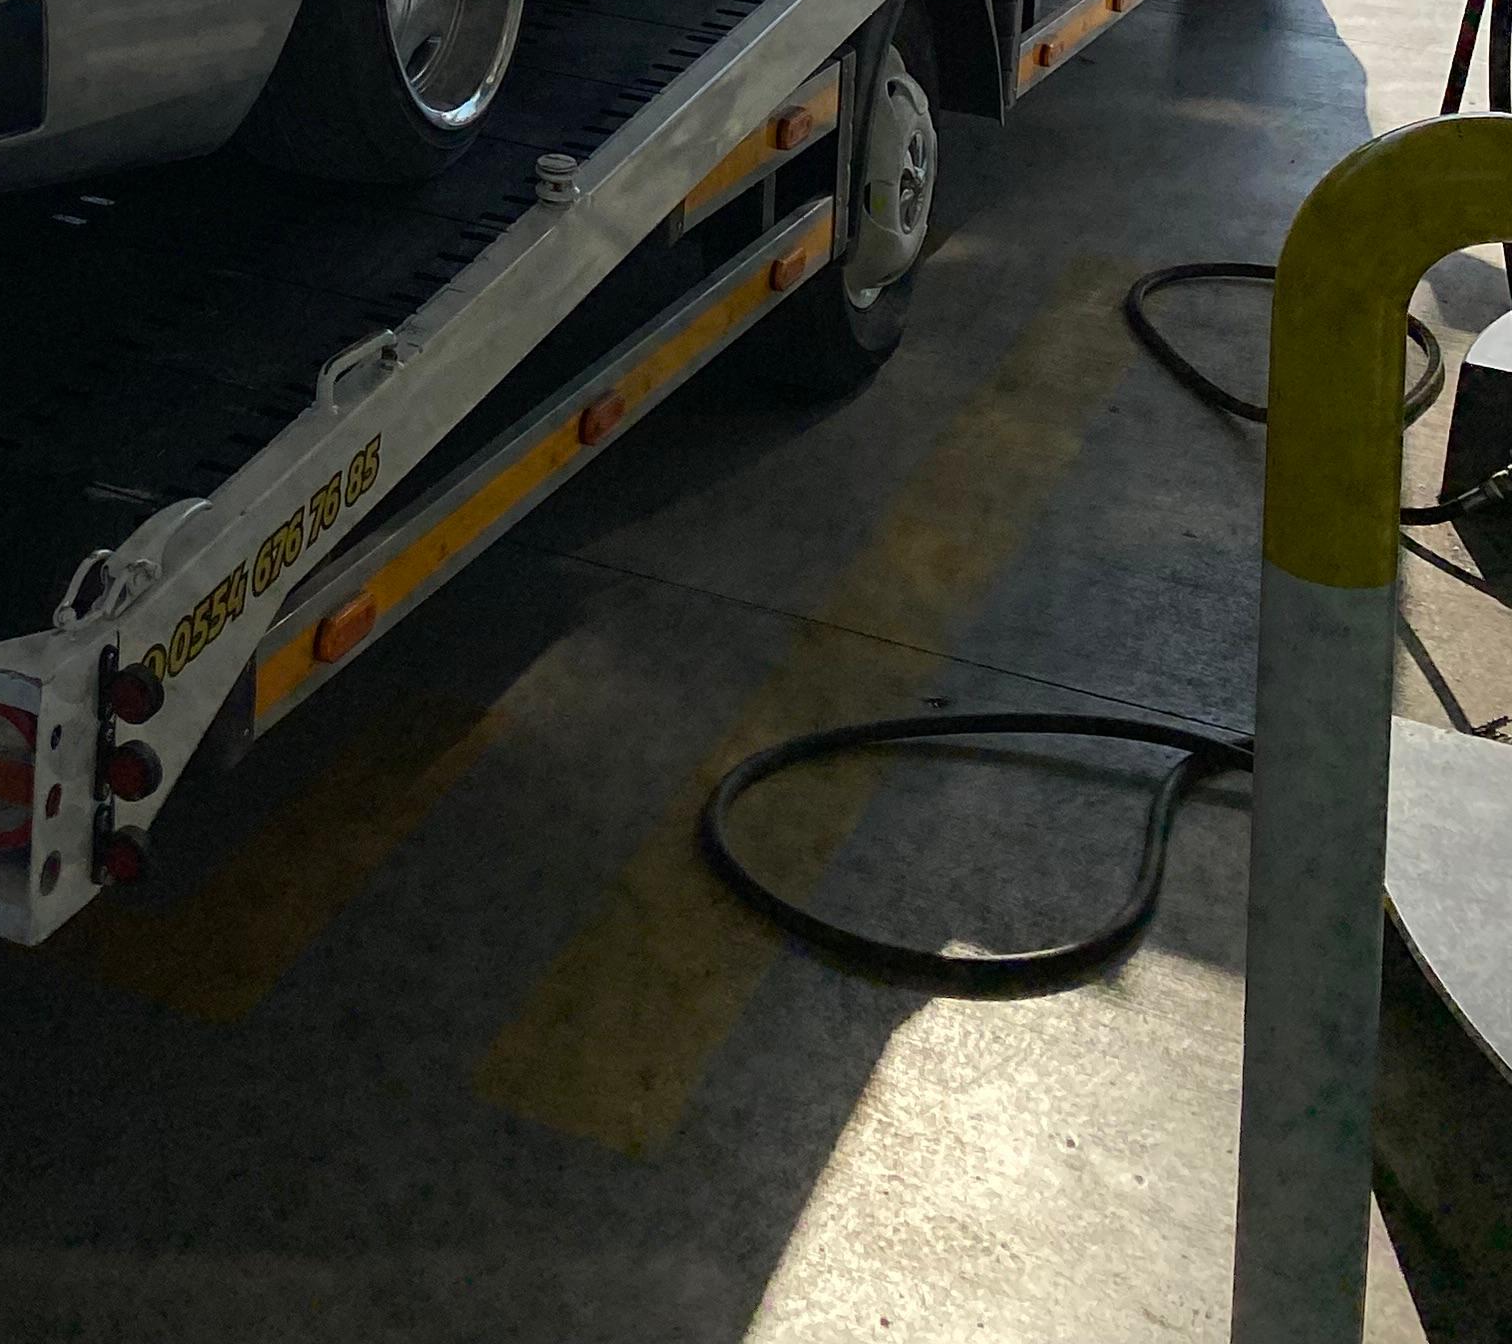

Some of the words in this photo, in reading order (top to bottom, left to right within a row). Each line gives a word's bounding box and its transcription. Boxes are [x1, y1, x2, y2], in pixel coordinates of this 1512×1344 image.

[168, 559, 248, 678] 0554
[251, 505, 306, 598] 676
[306, 470, 343, 551] 76
[344, 432, 382, 508] 85
